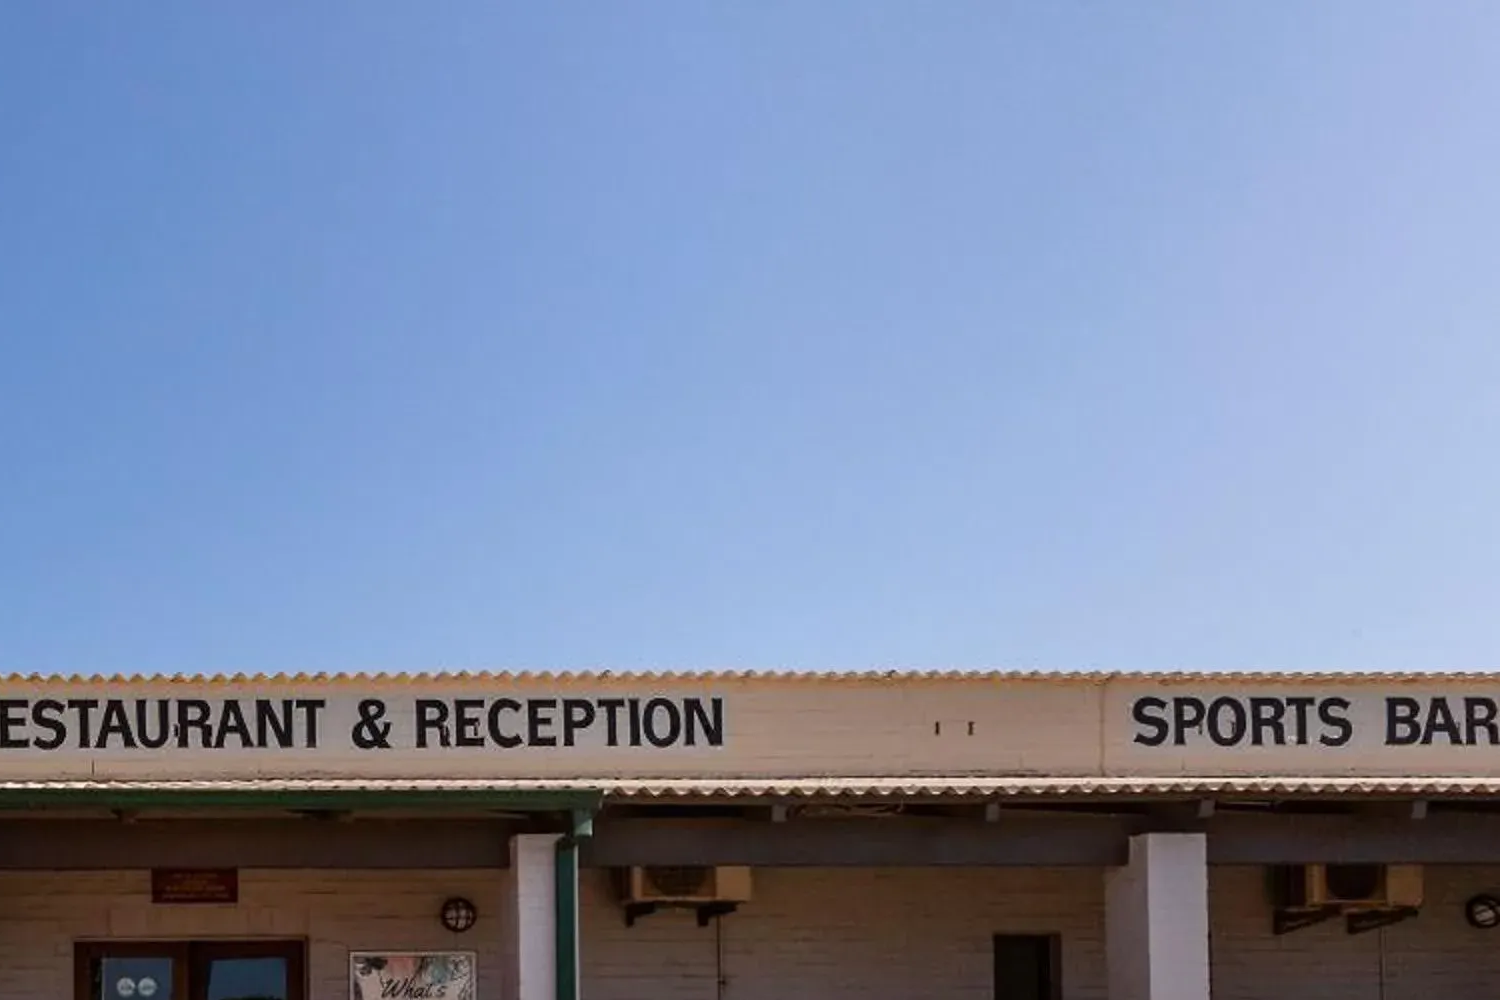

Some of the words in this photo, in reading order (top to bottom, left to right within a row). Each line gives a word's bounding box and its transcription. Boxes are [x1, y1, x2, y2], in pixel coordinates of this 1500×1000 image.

[350, 697, 391, 750] &
[415, 697, 724, 749] RECEPTION
[1131, 696, 1353, 747] SPORTS
[1385, 696, 1500, 746] BAR
